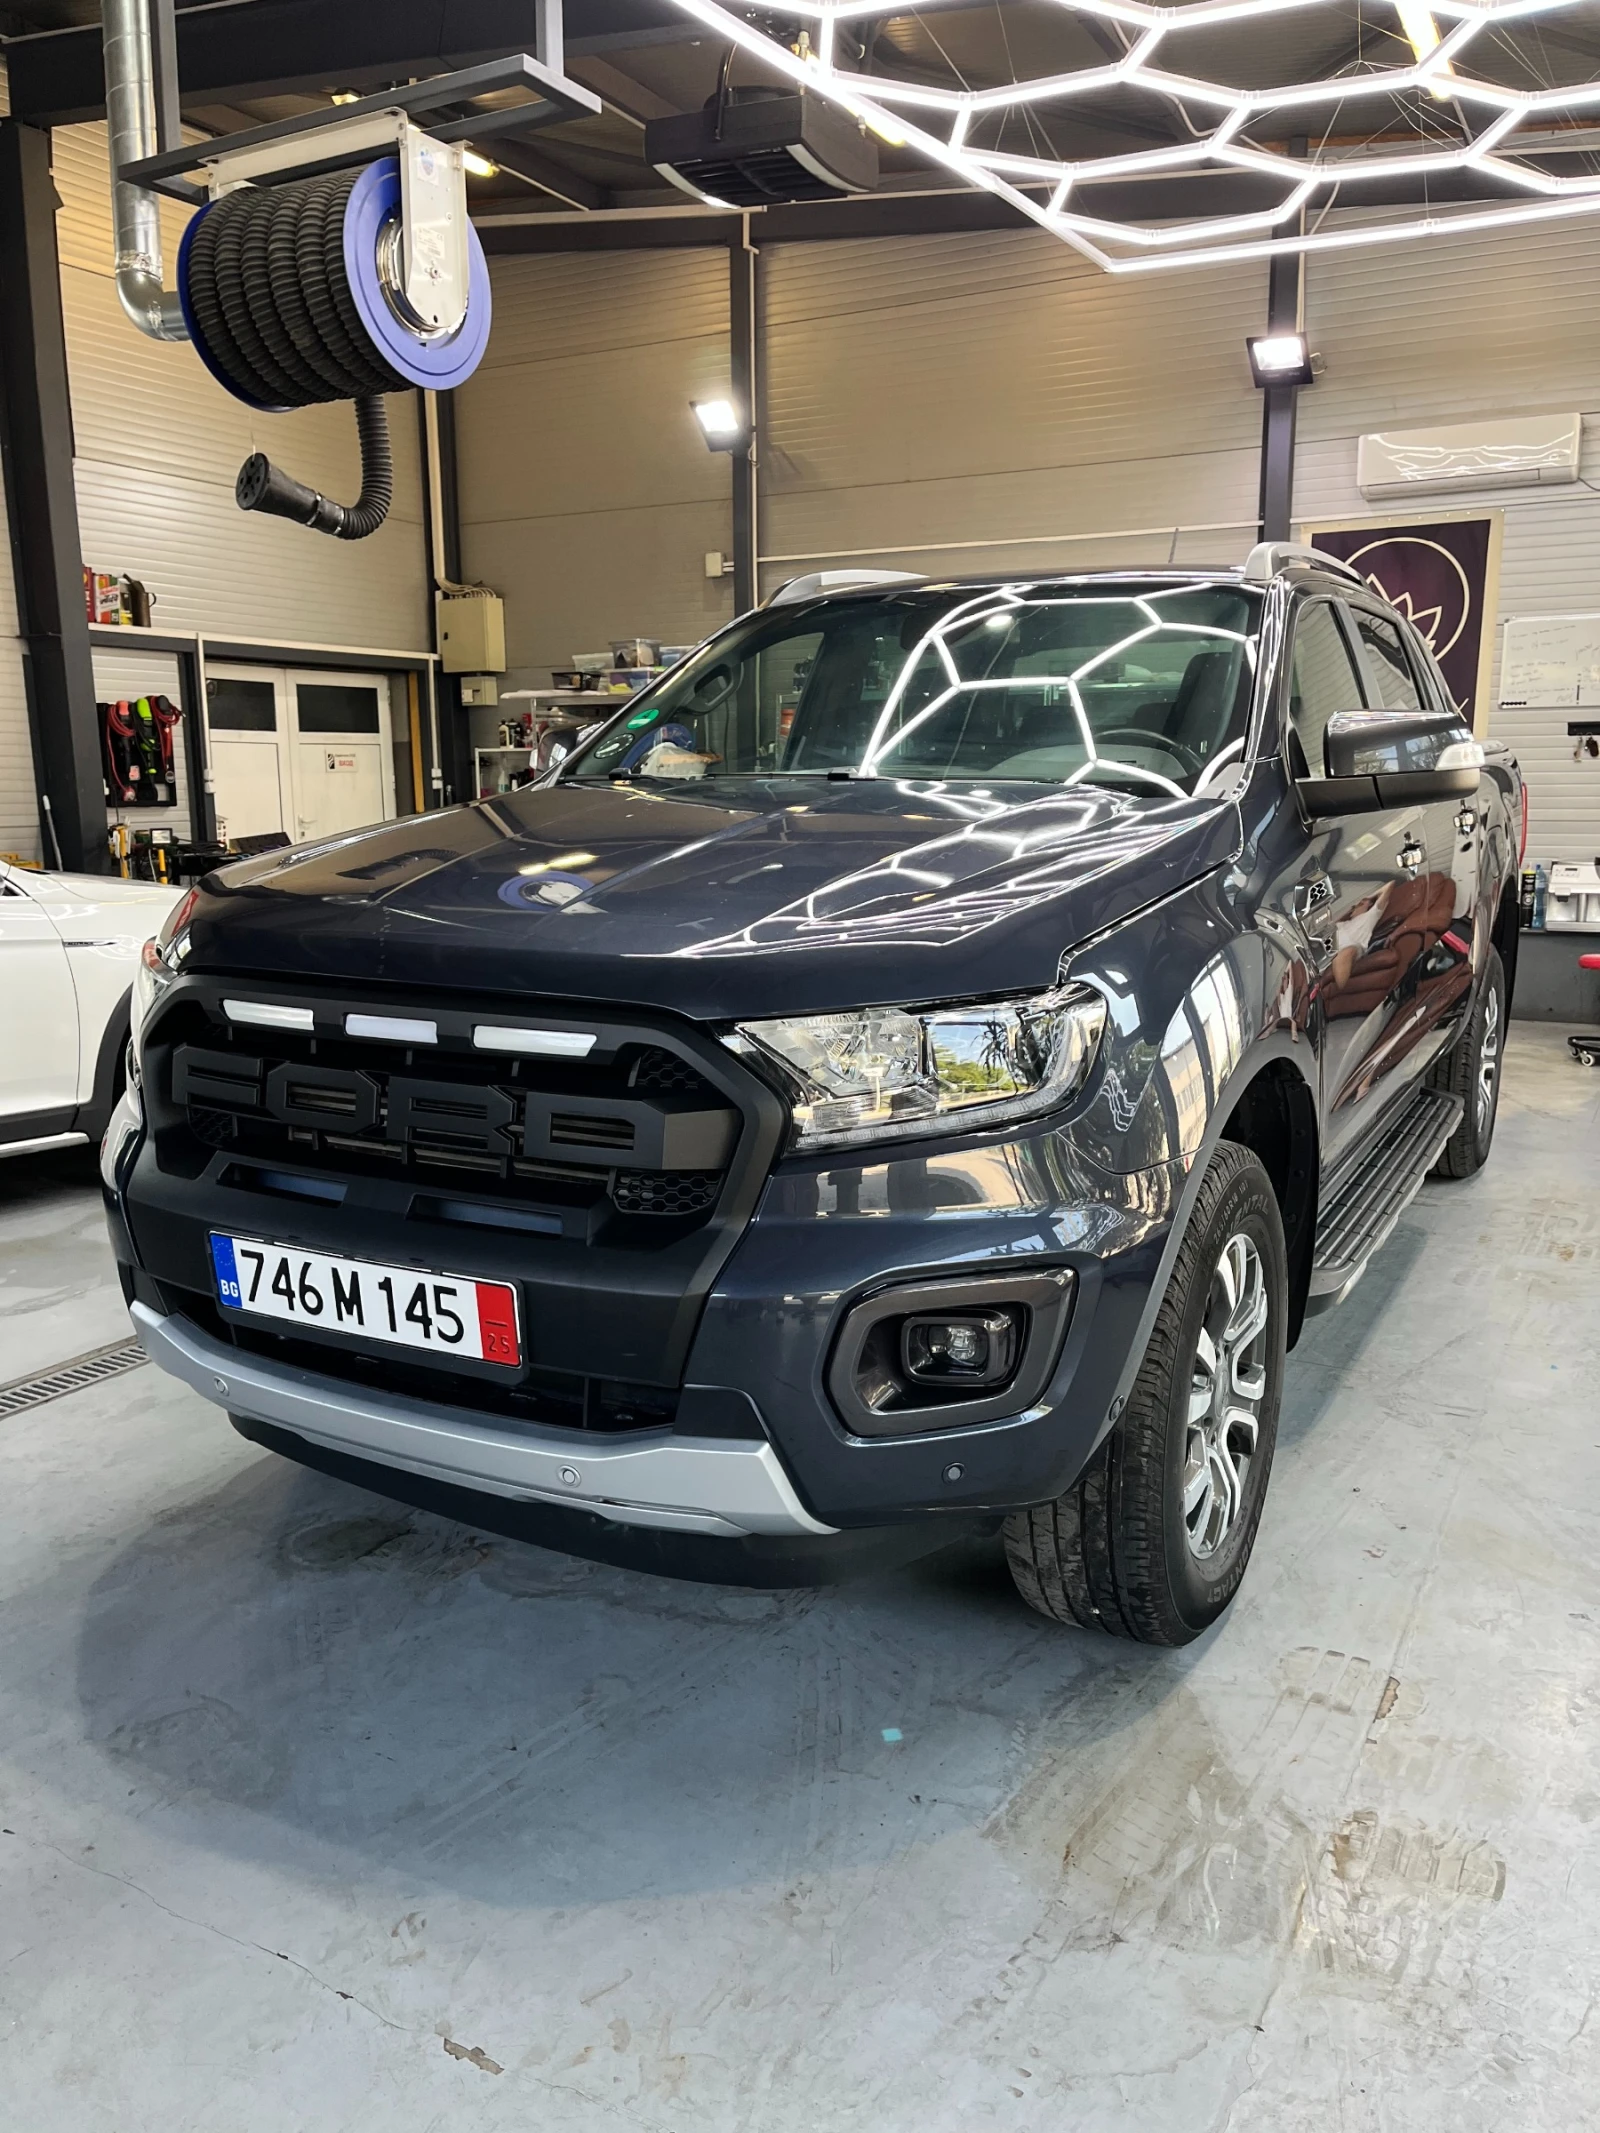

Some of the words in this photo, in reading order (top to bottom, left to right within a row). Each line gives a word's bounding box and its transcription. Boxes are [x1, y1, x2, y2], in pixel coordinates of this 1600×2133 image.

[172, 1043, 664, 1170] FORD
[220, 1278, 239, 1298] BG
[240, 1248, 324, 1316] 746
[331, 1266, 365, 1326] M
[377, 1275, 465, 1344] 145
[487, 1332, 511, 1354] 25
